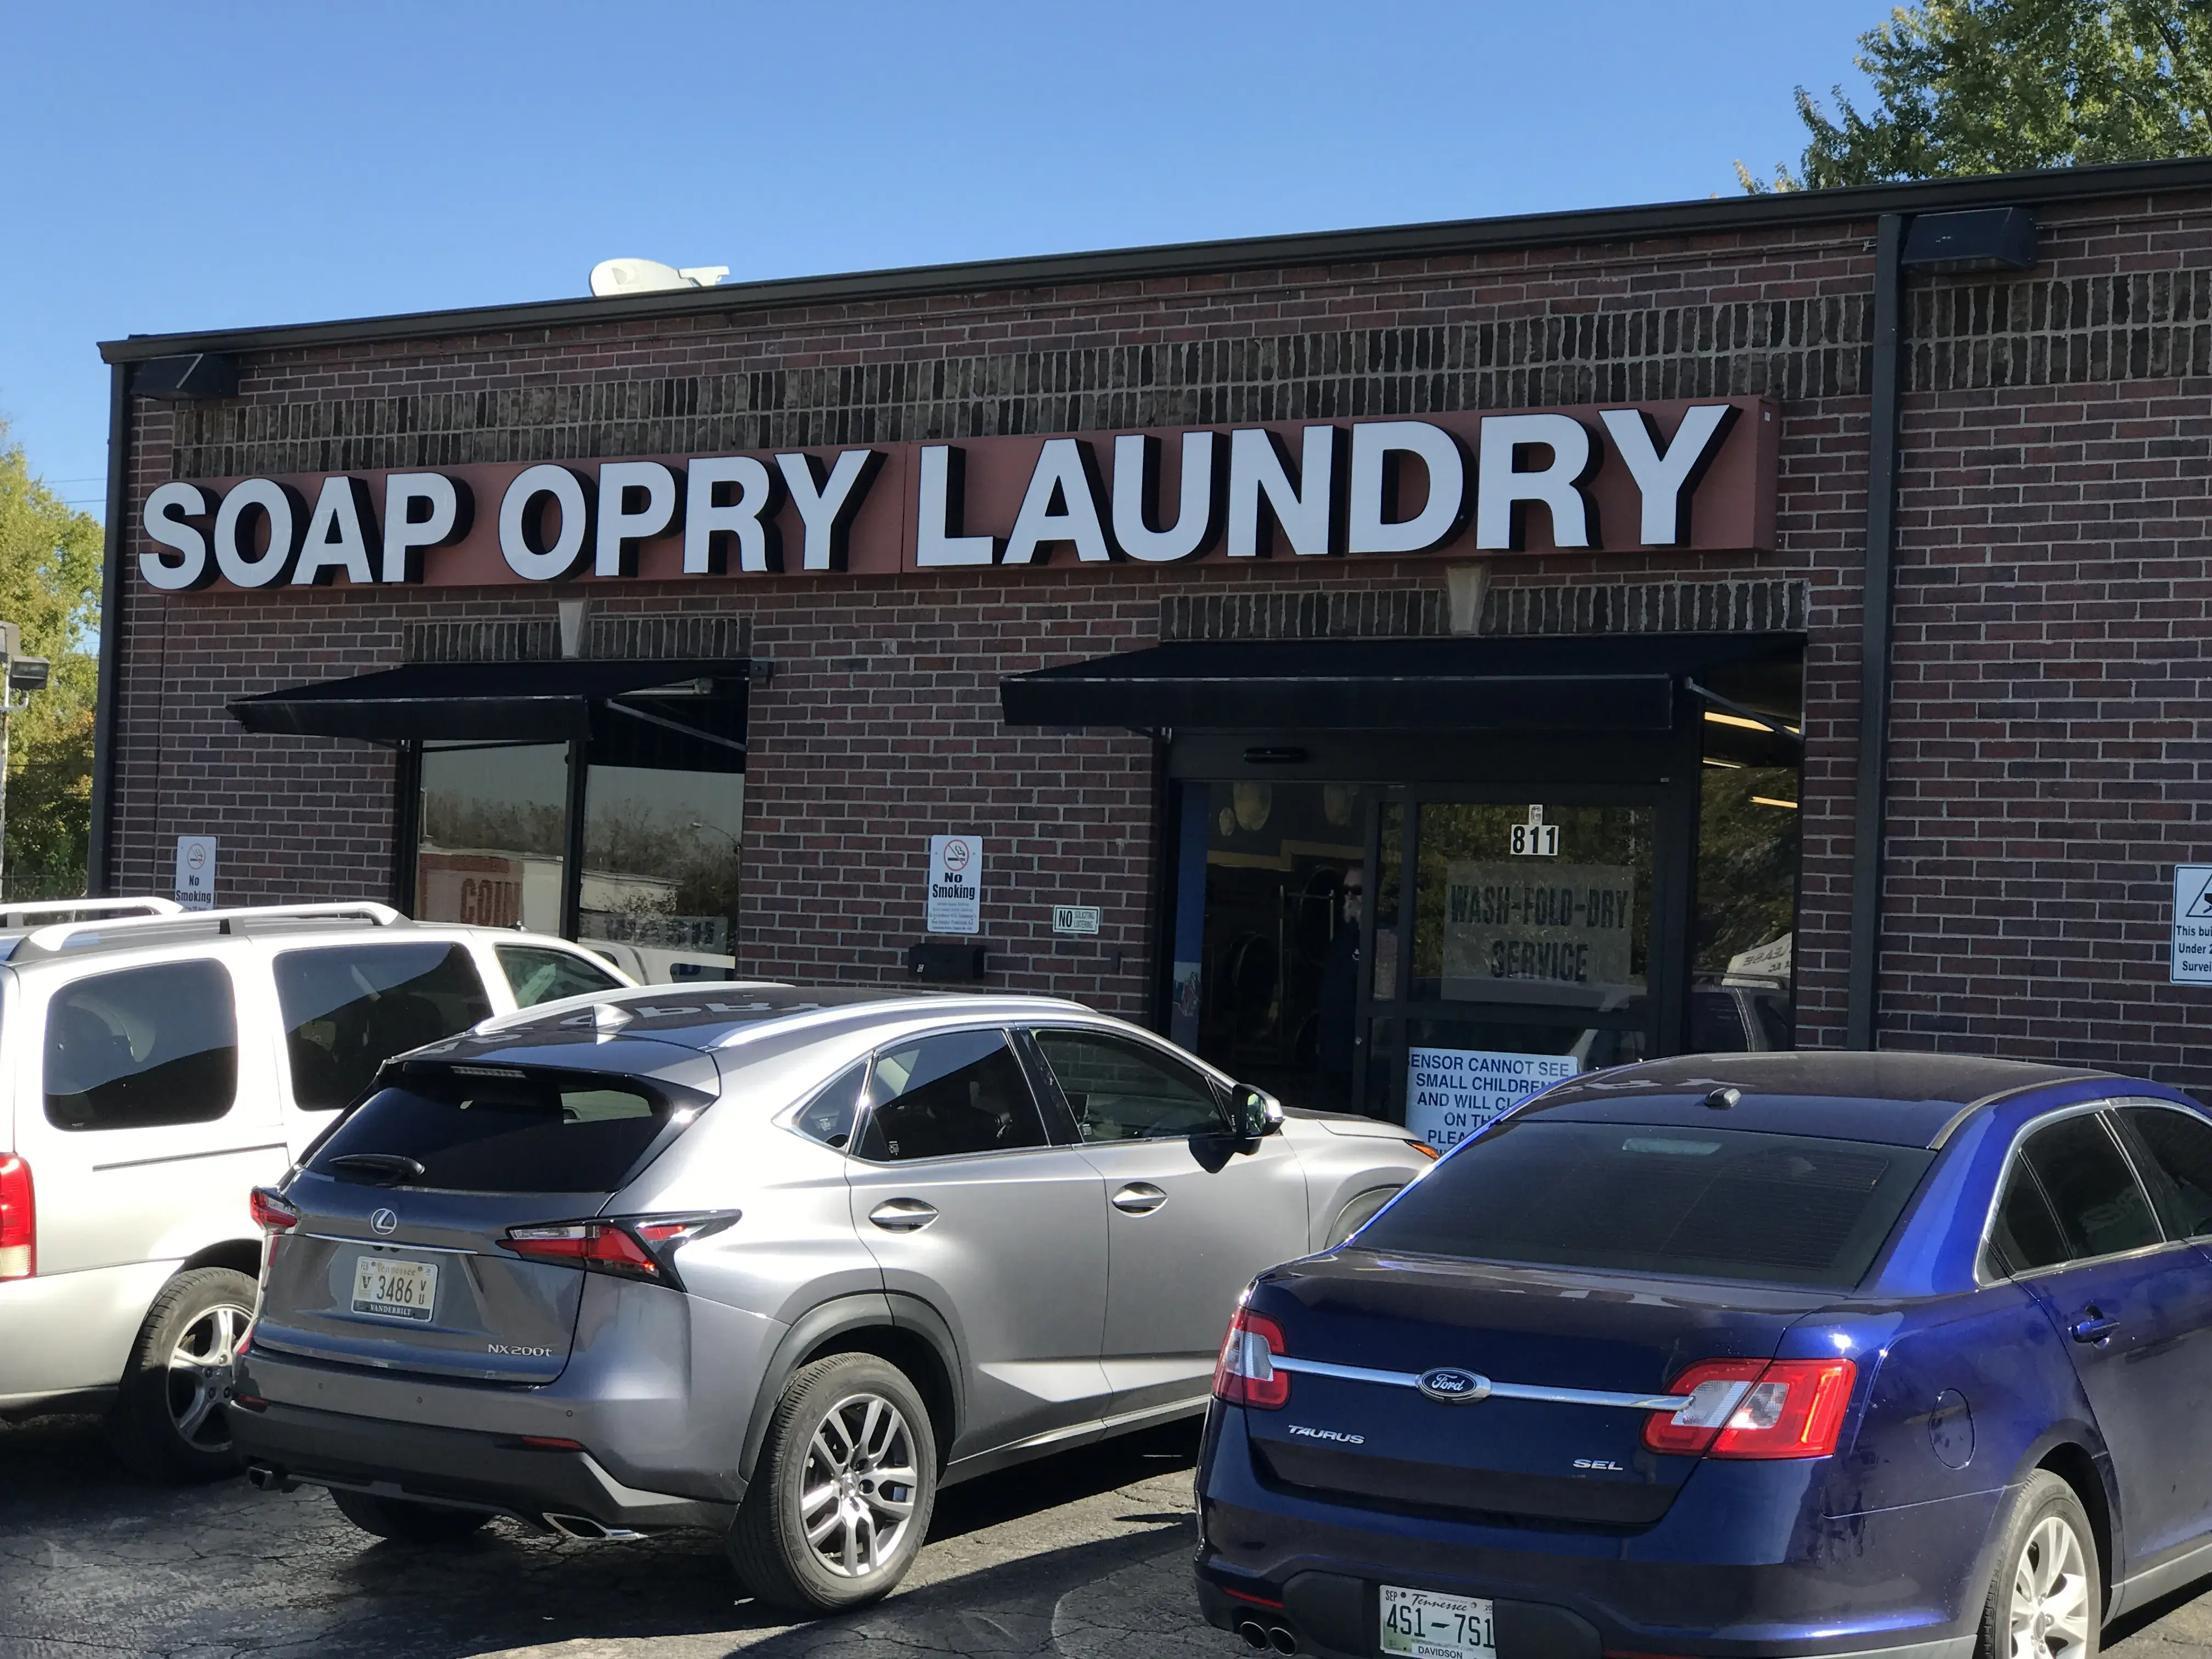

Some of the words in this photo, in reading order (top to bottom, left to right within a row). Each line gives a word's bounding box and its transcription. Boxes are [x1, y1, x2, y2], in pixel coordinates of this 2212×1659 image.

[138, 472, 459, 590] SOAP
[498, 449, 872, 580] OPRY
[915, 404, 1733, 567] LAUNDRY
[1513, 826, 1556, 854] 811
[188, 874, 200, 886] No
[944, 872, 963, 883] No
[176, 890, 212, 904] Smoking
[932, 884, 975, 900] Smoking
[1058, 910, 1073, 927] NO
[2176, 925, 2196, 936] This
[2179, 943, 2207, 953] Under
[1491, 940, 1589, 982] SERVICE
[1469, 1057, 1534, 1074] CANNOT
[1538, 1062, 1570, 1077] SEE
[1416, 1073, 1468, 1089] SMALL
[1418, 1092, 1449, 1106] AND
[1454, 1093, 1491, 1110] WILL
[1444, 1111, 1466, 1127] ON
[376, 1263, 416, 1277] Tennessee
[376, 1275, 413, 1304] 3486
[370, 1304, 411, 1316] VANDERBILT
[1431, 1373, 1465, 1391] Ford
[1288, 1425, 1365, 1444] TAURUS
[1572, 1459, 1623, 1471] SEL
[1385, 1589, 1398, 1602] SEP
[1411, 1593, 1468, 1611] Tennessee
[1418, 1646, 1463, 1659] DAVIDSON
